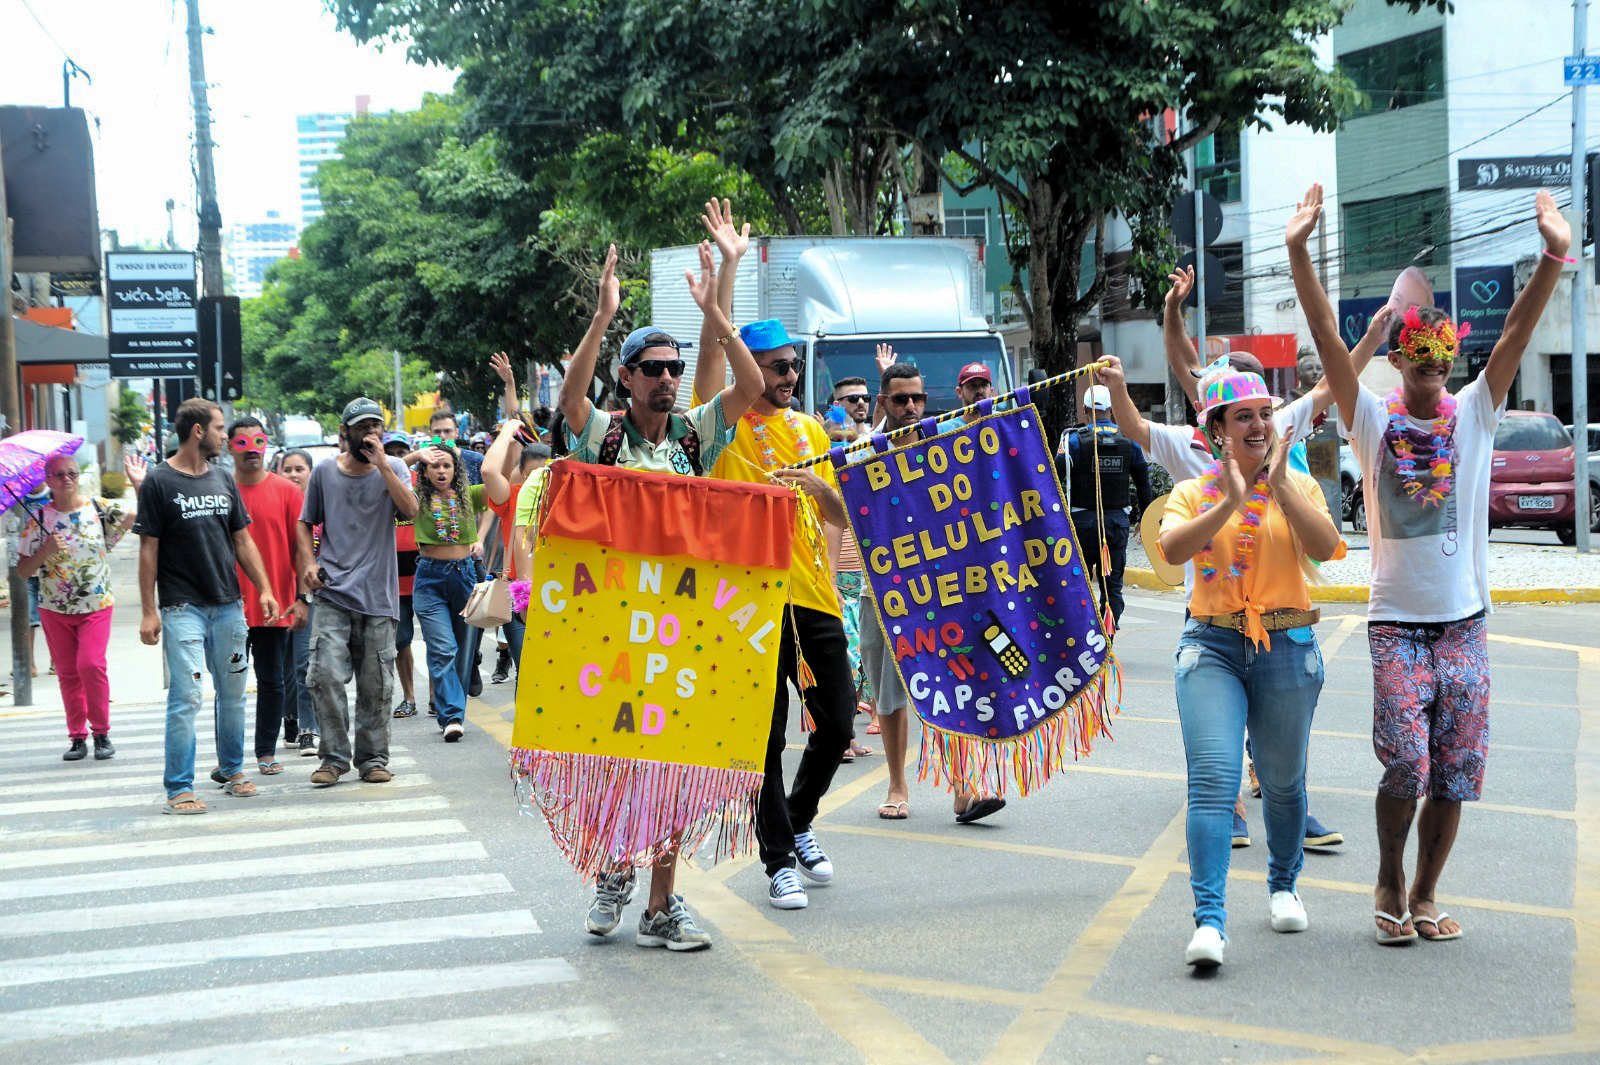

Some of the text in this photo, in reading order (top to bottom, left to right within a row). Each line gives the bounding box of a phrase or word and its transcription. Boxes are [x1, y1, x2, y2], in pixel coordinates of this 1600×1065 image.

[1572, 65, 1595, 79] 22
[1461, 308, 1484, 318] Droga
[864, 426, 1000, 492] BLOCO
[180, 495, 229, 511] MUSIC
[928, 473, 973, 512] DO
[182, 509, 214, 519] COMPANY
[869, 489, 1045, 575] CELULAR
[1441, 500, 1458, 556] Calvin
[883, 537, 1073, 618] QUEBRADO
[541, 557, 776, 655] CARNAVAL
[629, 610, 681, 646] DO
[895, 621, 964, 662] ANO
[578, 651, 698, 699] CAPS
[909, 629, 1107, 731] CAPS FLORES
[613, 701, 666, 736] AD
